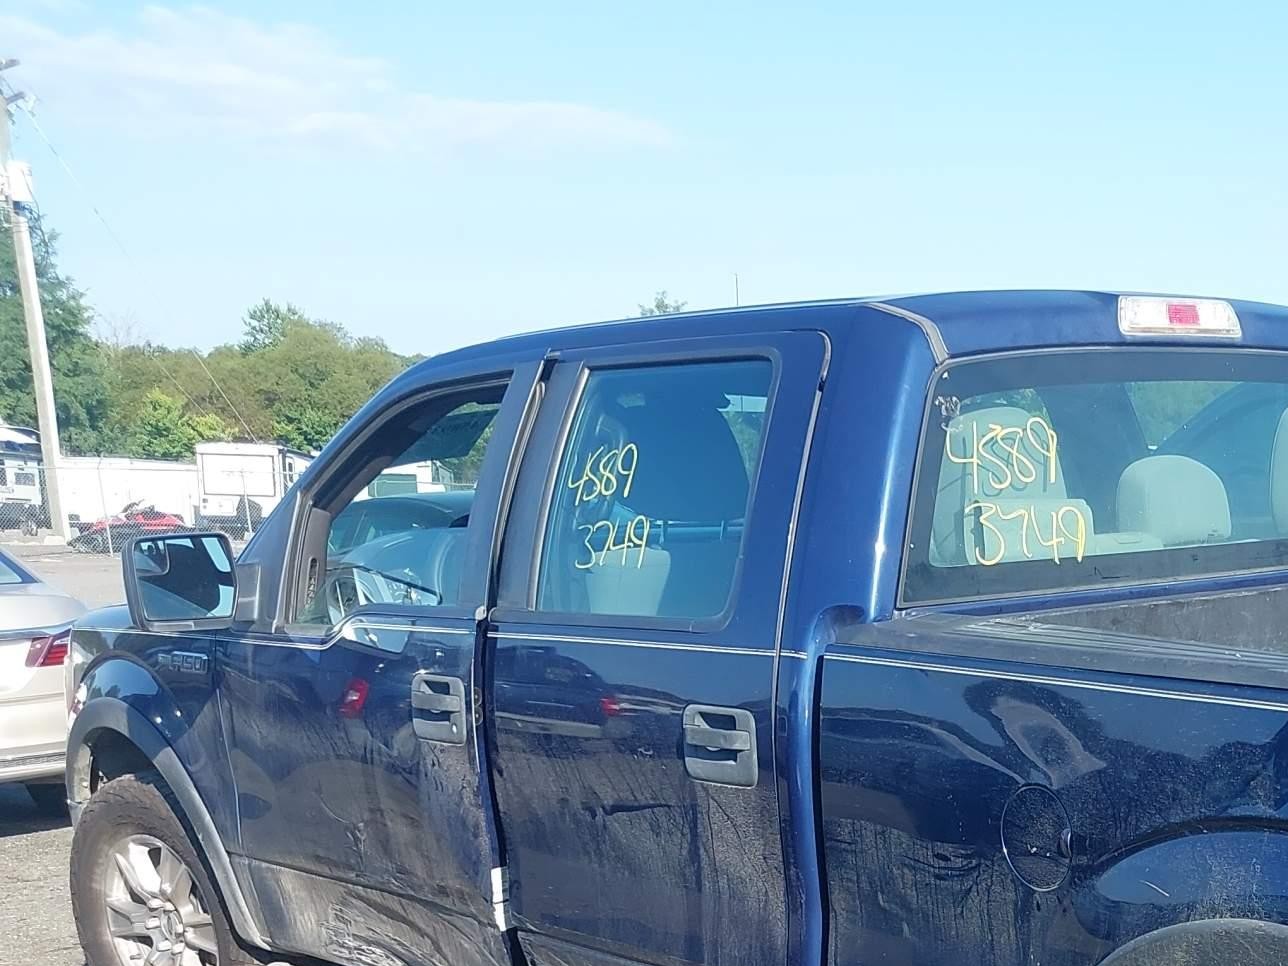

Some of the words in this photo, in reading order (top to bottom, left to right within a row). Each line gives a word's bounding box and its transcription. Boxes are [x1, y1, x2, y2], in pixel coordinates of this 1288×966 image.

[568, 443, 638, 506] 4589
[944, 416, 1058, 494] 4589
[575, 515, 650, 569] 3749
[965, 501, 1087, 566] 3749
